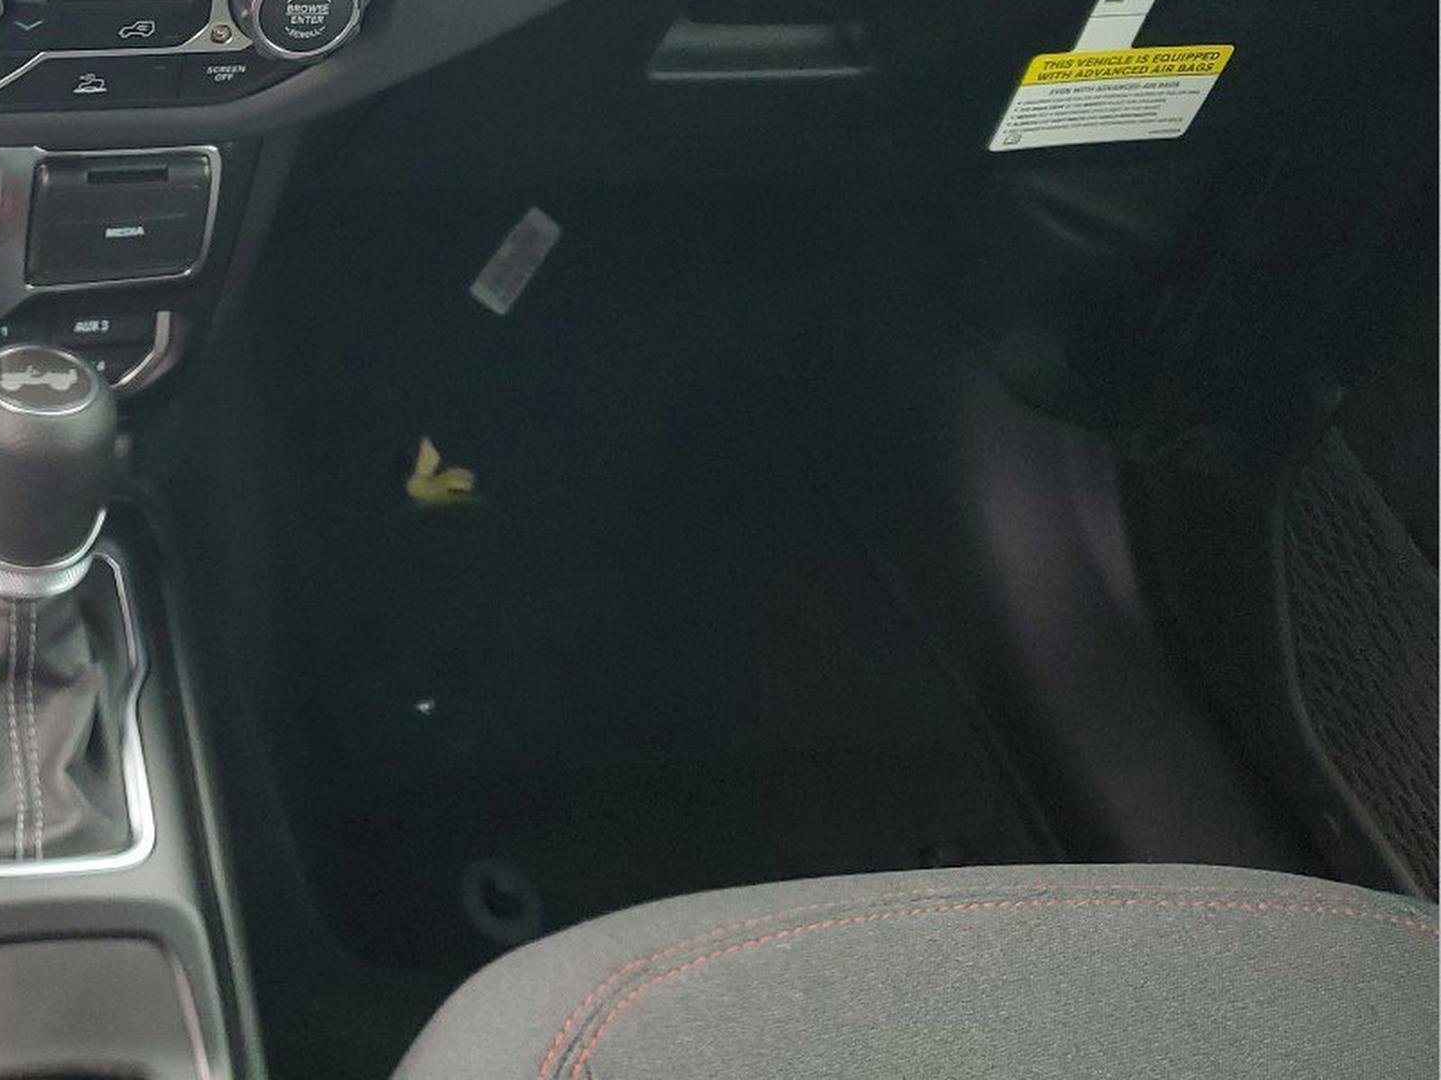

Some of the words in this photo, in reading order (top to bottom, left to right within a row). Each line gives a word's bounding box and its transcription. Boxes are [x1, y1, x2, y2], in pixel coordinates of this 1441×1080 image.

[287, 4, 330, 14] BROWSE
[291, 16, 325, 25] ENTER
[1042, 59, 1074, 70] THIS
[1076, 54, 1133, 67] VEHICLE
[1135, 54, 1149, 64] IS
[1151, 51, 1220, 64] EQUIPPED
[207, 65, 247, 76] SCREEN
[1037, 71, 1072, 81] WITH
[1074, 64, 1148, 79] ADVANCED
[1150, 63, 1174, 74] AIR
[1177, 62, 1214, 73] BAGS
[214, 73, 236, 82] OFF
[105, 225, 145, 238] MEDIA
